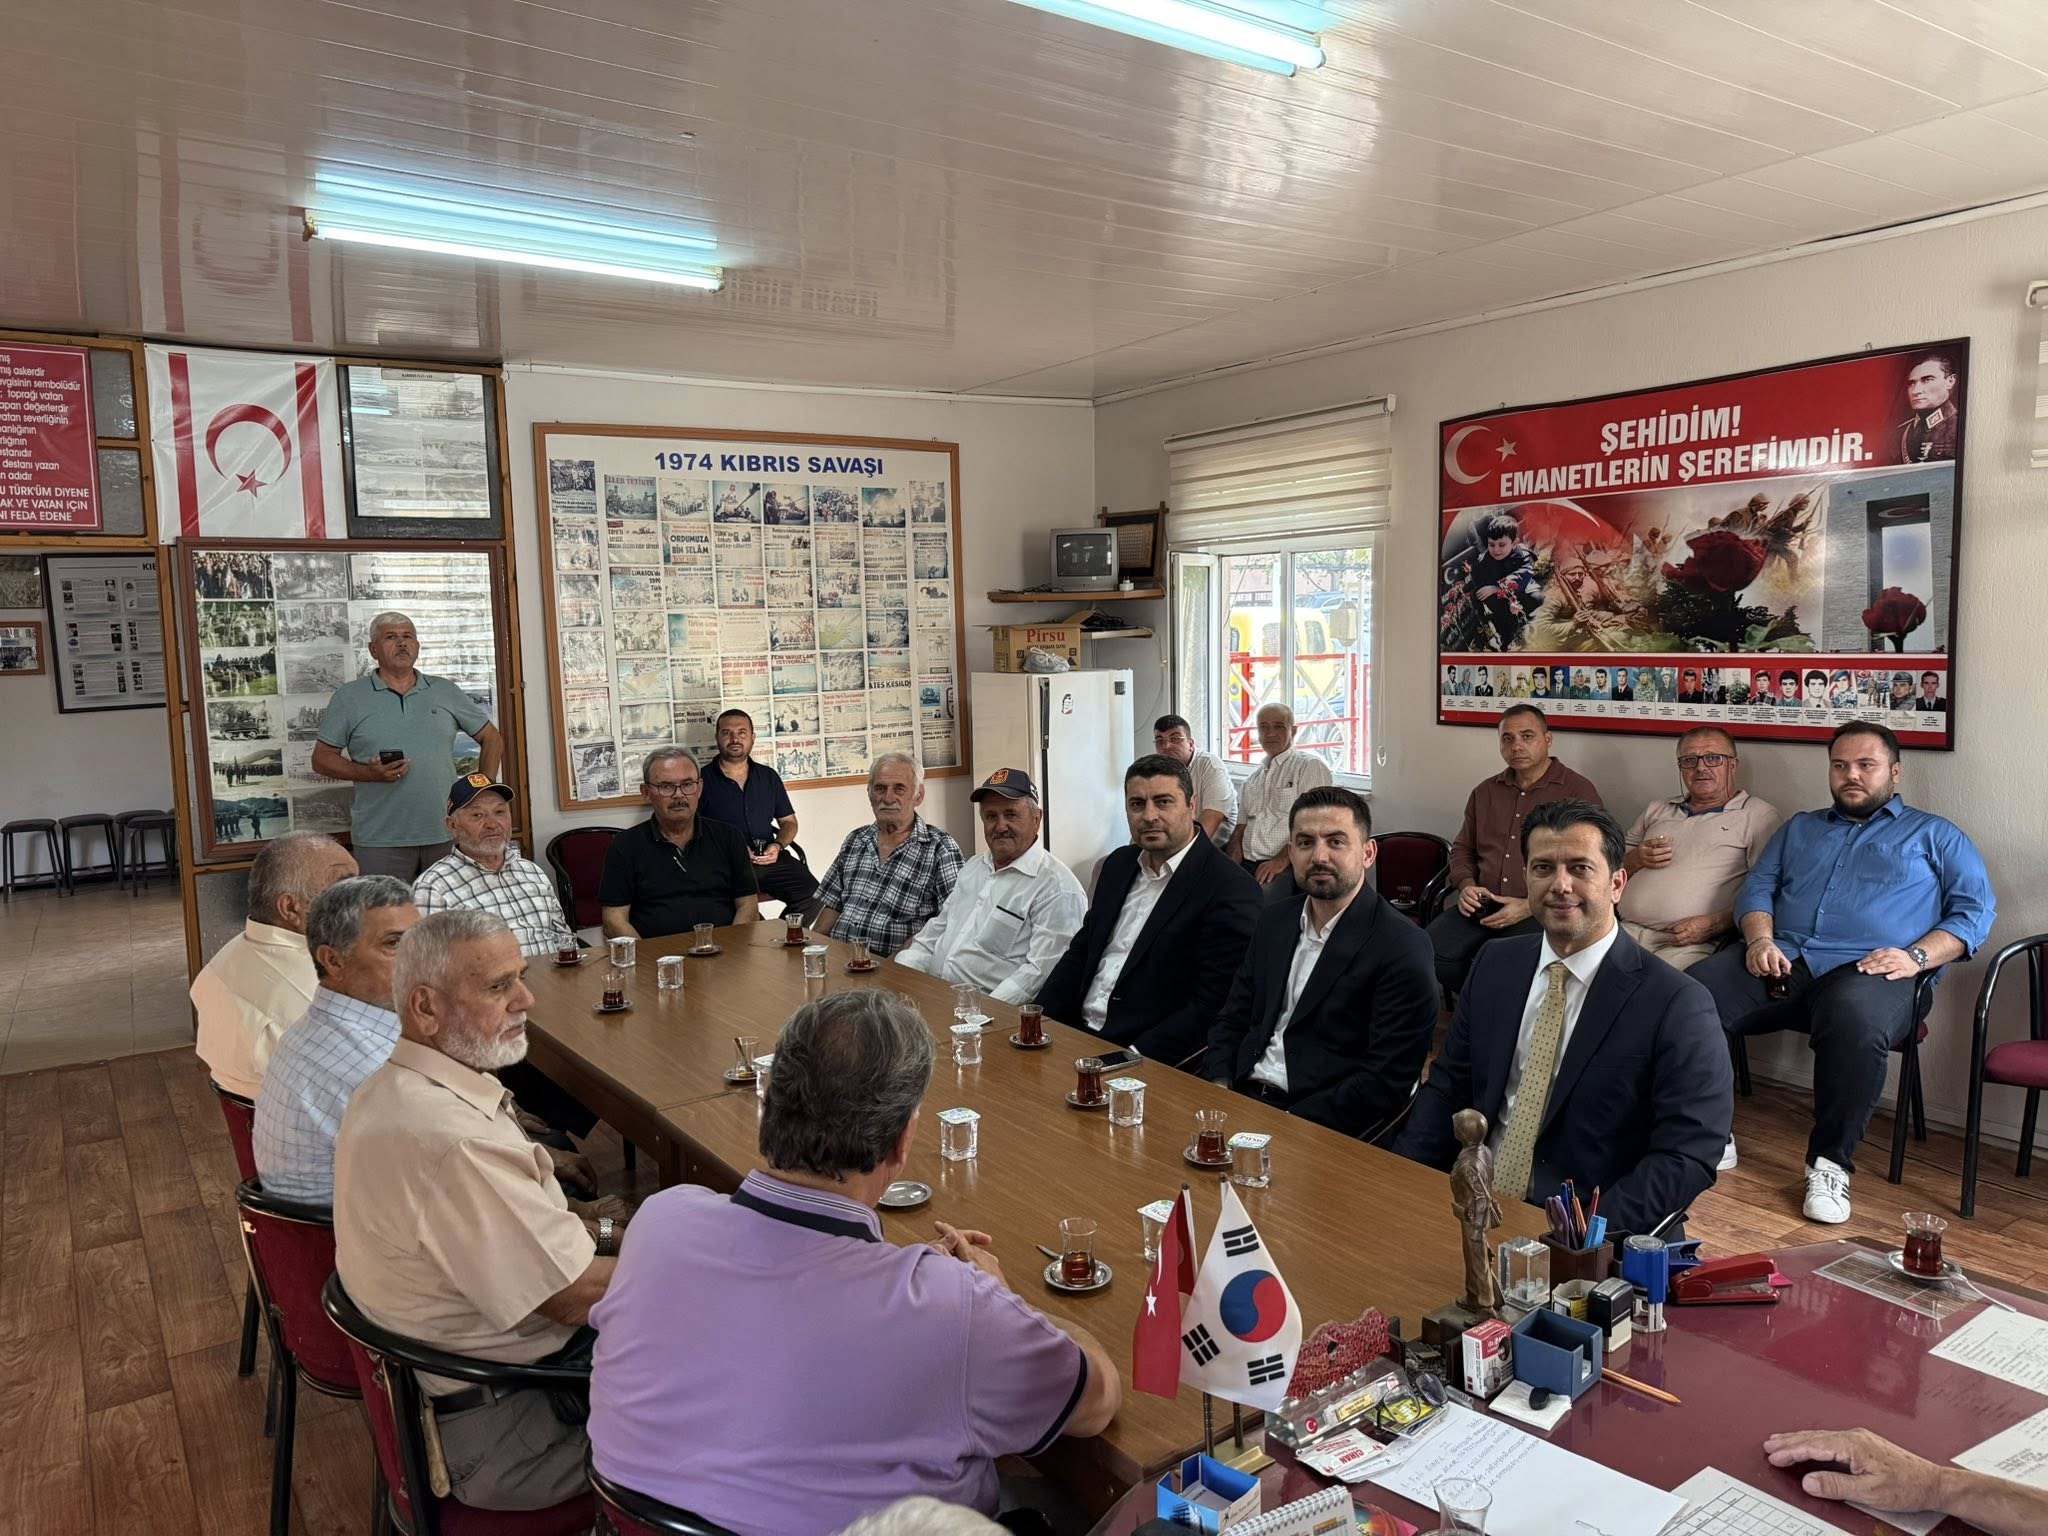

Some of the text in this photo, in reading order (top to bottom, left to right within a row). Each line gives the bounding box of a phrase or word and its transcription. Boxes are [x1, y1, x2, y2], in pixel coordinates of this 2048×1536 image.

[13, 366, 45, 376] askerdir
[34, 380, 80, 391] sembolüdür
[8, 389, 63, 401] toprağı vatan
[23, 401, 68, 413] değerlerdir
[0, 424, 37, 435] anlığının
[1600, 405, 1741, 456] ŞEHİDİM!
[2, 459, 59, 471] destanı yazan
[655, 453, 883, 478] 1974 KIBRIS SAVAŞI
[1501, 428, 1873, 497] EMANETLERİN ŞEREFİMDİR.
[8, 472, 32, 480] adıdır
[9, 484, 52, 496] TÜRK'ÜM
[55, 487, 89, 497] DİYENE
[16, 499, 29, 508] VE
[32, 499, 64, 509] VATAN
[11, 511, 37, 520] FEDA
[40, 512, 72, 521] EDENE
[1026, 628, 1066, 642] Pirsu
